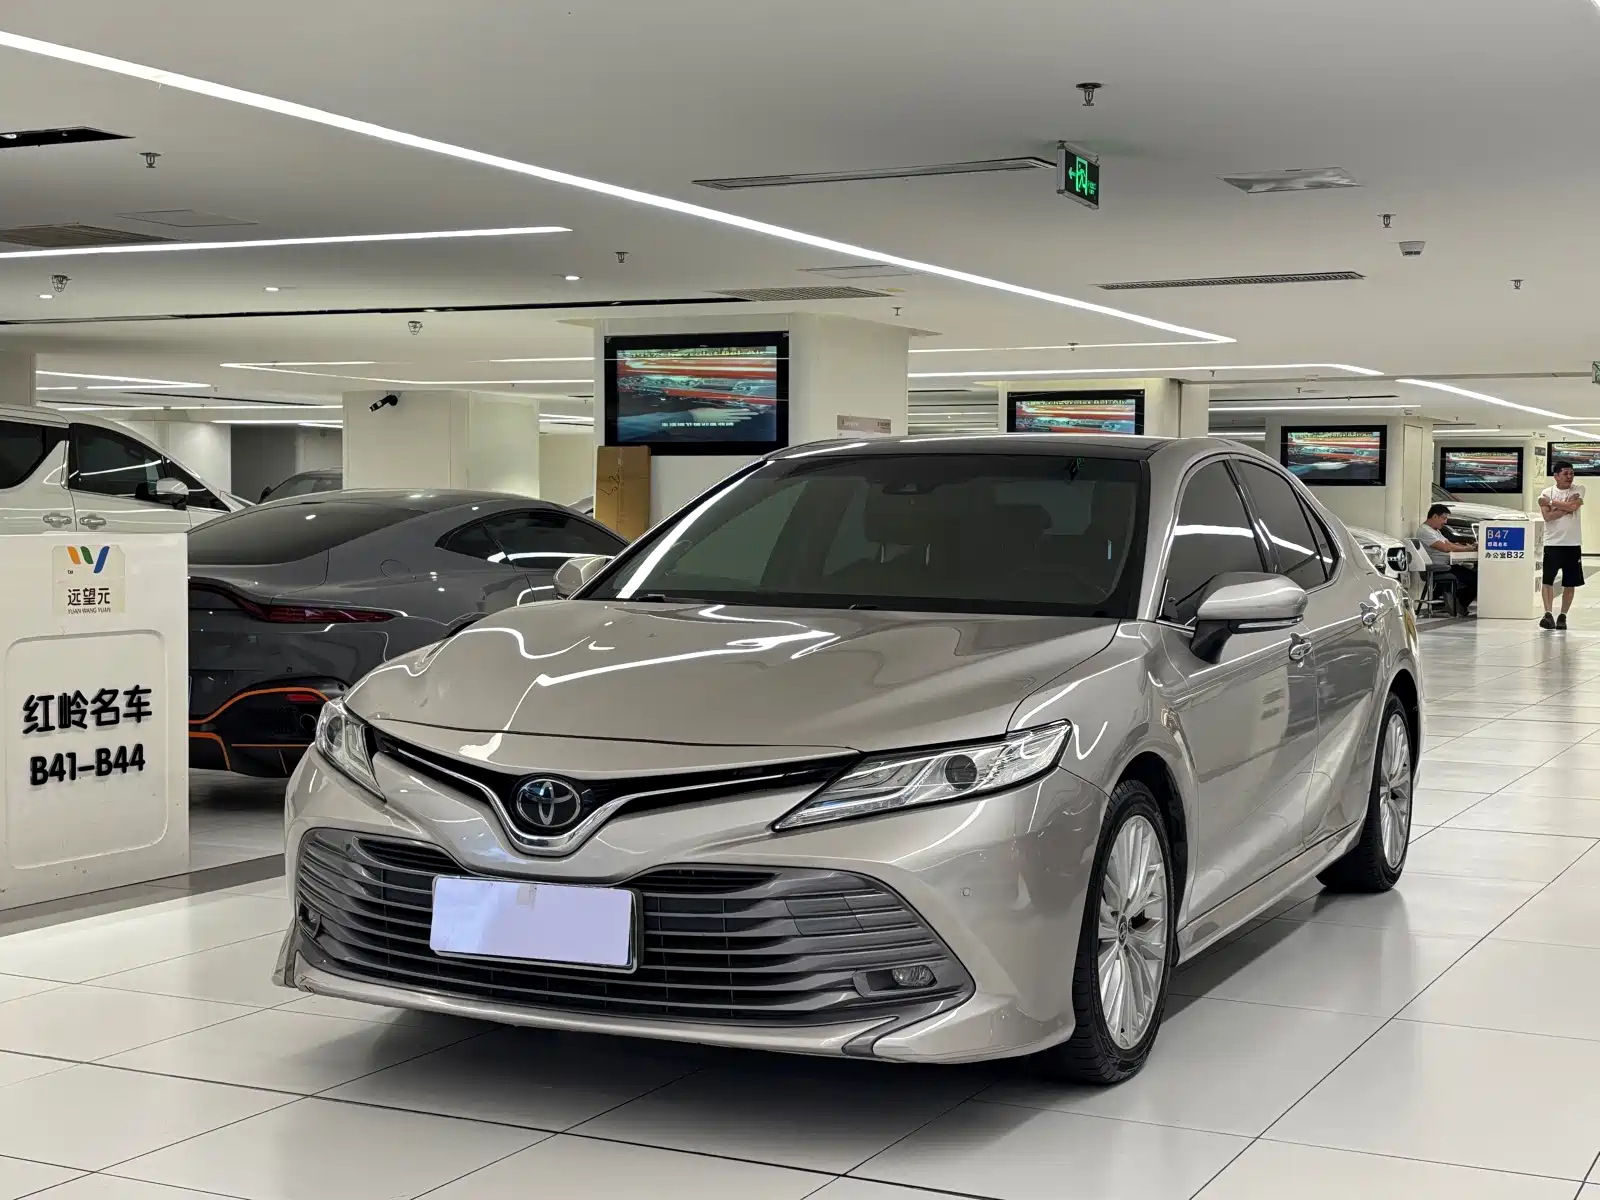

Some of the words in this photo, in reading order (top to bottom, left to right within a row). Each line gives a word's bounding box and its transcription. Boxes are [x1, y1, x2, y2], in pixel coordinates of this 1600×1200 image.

[1487, 529, 1509, 539] B47
[67, 587, 111, 606] 远望元
[22, 684, 153, 735] 红岭名车
